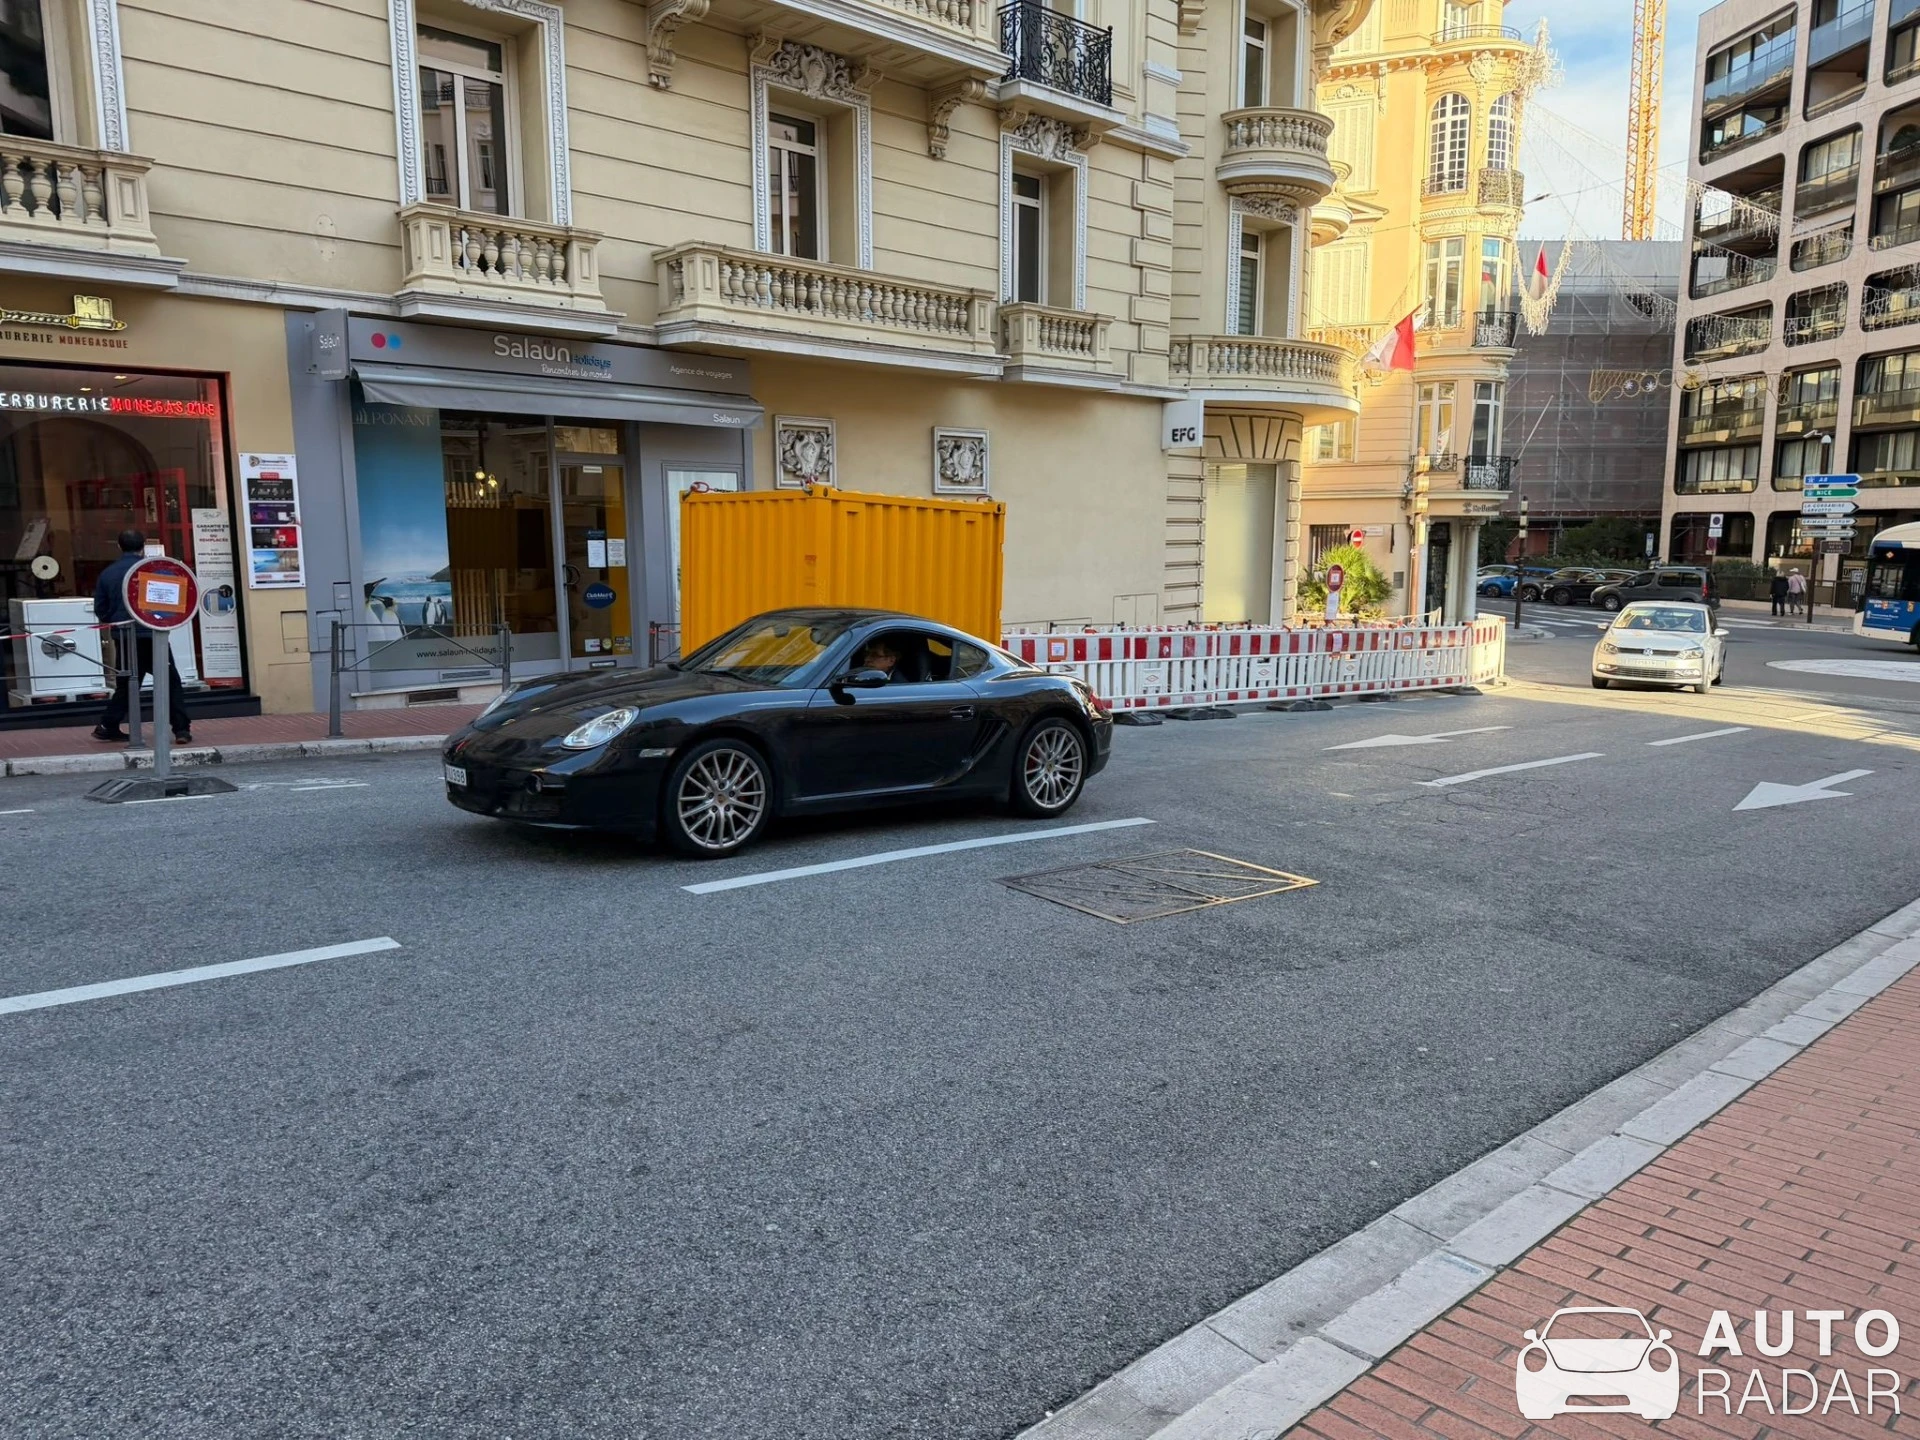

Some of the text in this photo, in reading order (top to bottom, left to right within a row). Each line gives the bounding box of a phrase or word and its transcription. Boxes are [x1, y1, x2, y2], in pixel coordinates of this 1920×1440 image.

[59, 335, 129, 349] MONEGASQUE
[493, 334, 570, 362] Salaün
[589, 369, 613, 380] monde
[670, 365, 734, 380] Agence de voyages
[111, 397, 215, 416] MONEGASQUE
[371, 411, 433, 427] PONANT
[1172, 427, 1196, 442] EFG
